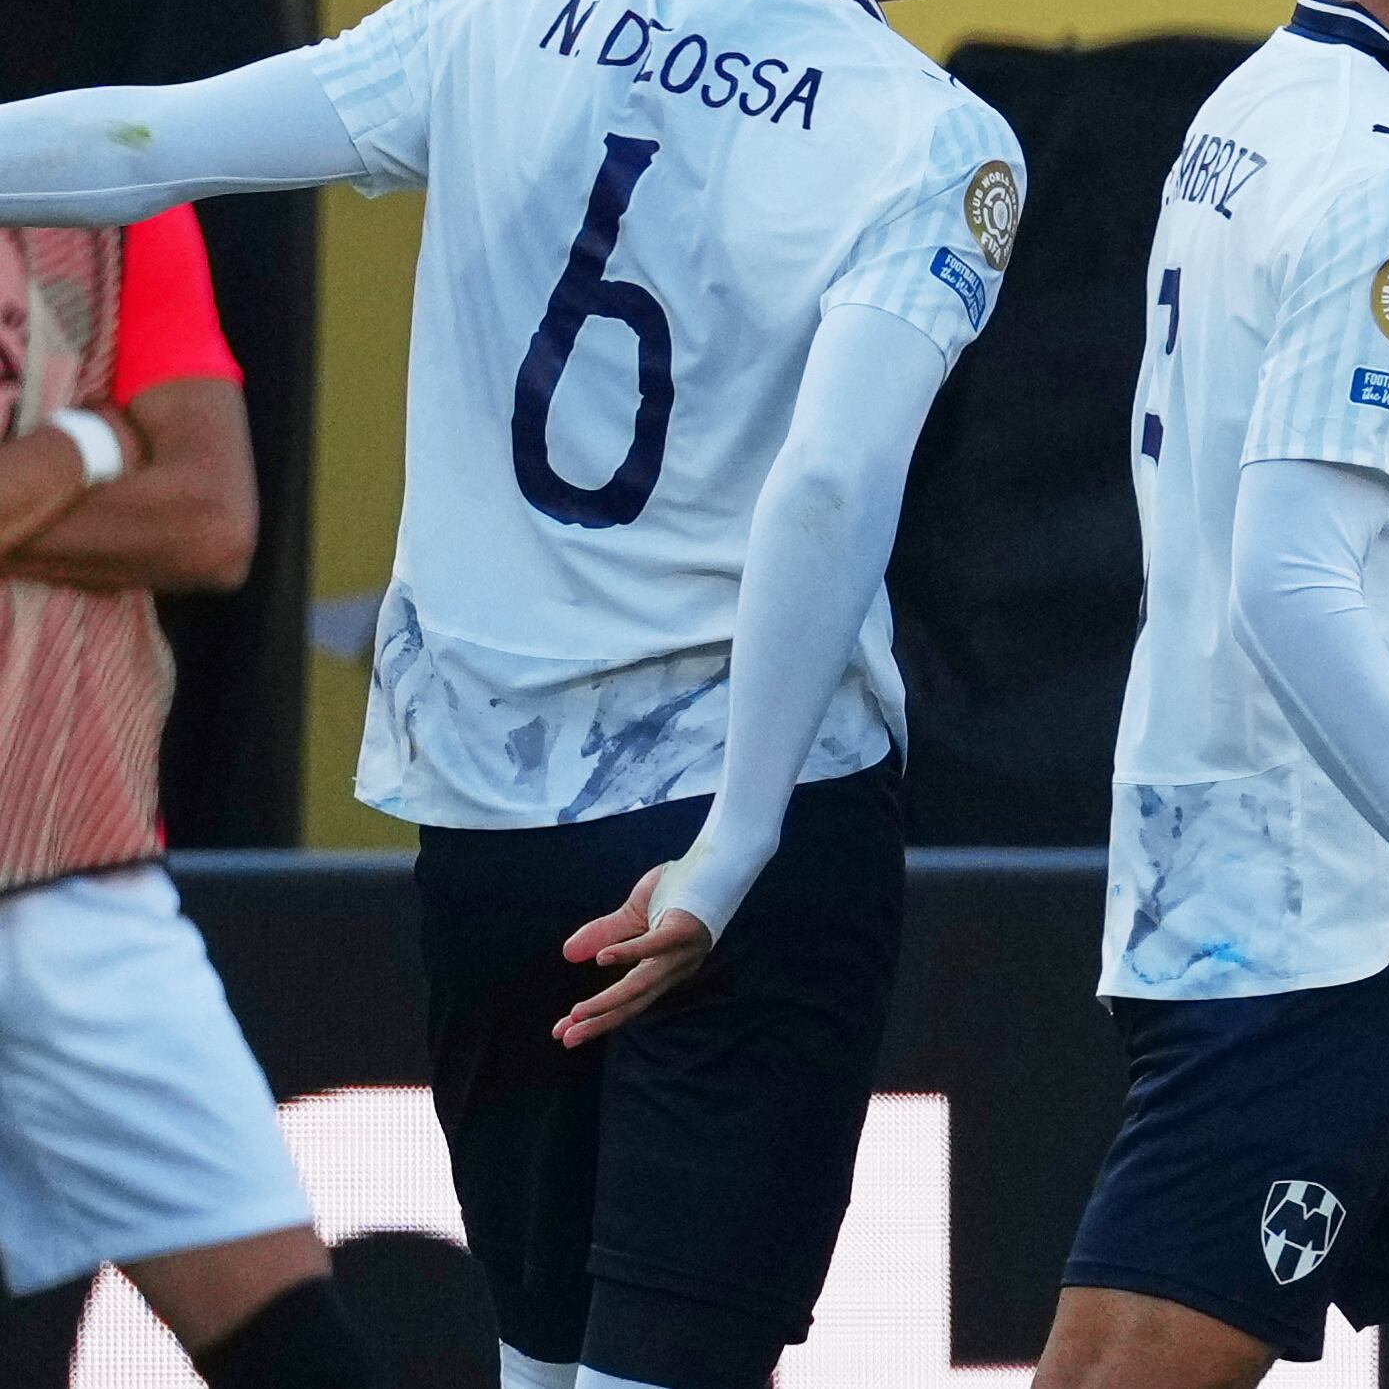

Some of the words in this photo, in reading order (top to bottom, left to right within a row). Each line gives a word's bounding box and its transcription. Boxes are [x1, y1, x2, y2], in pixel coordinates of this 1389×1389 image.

[1164, 134, 1268, 220] MBRIZ
[980, 230, 1001, 264] FIFA
[511, 132, 676, 530] 6
[1361, 386, 1381, 402] the
